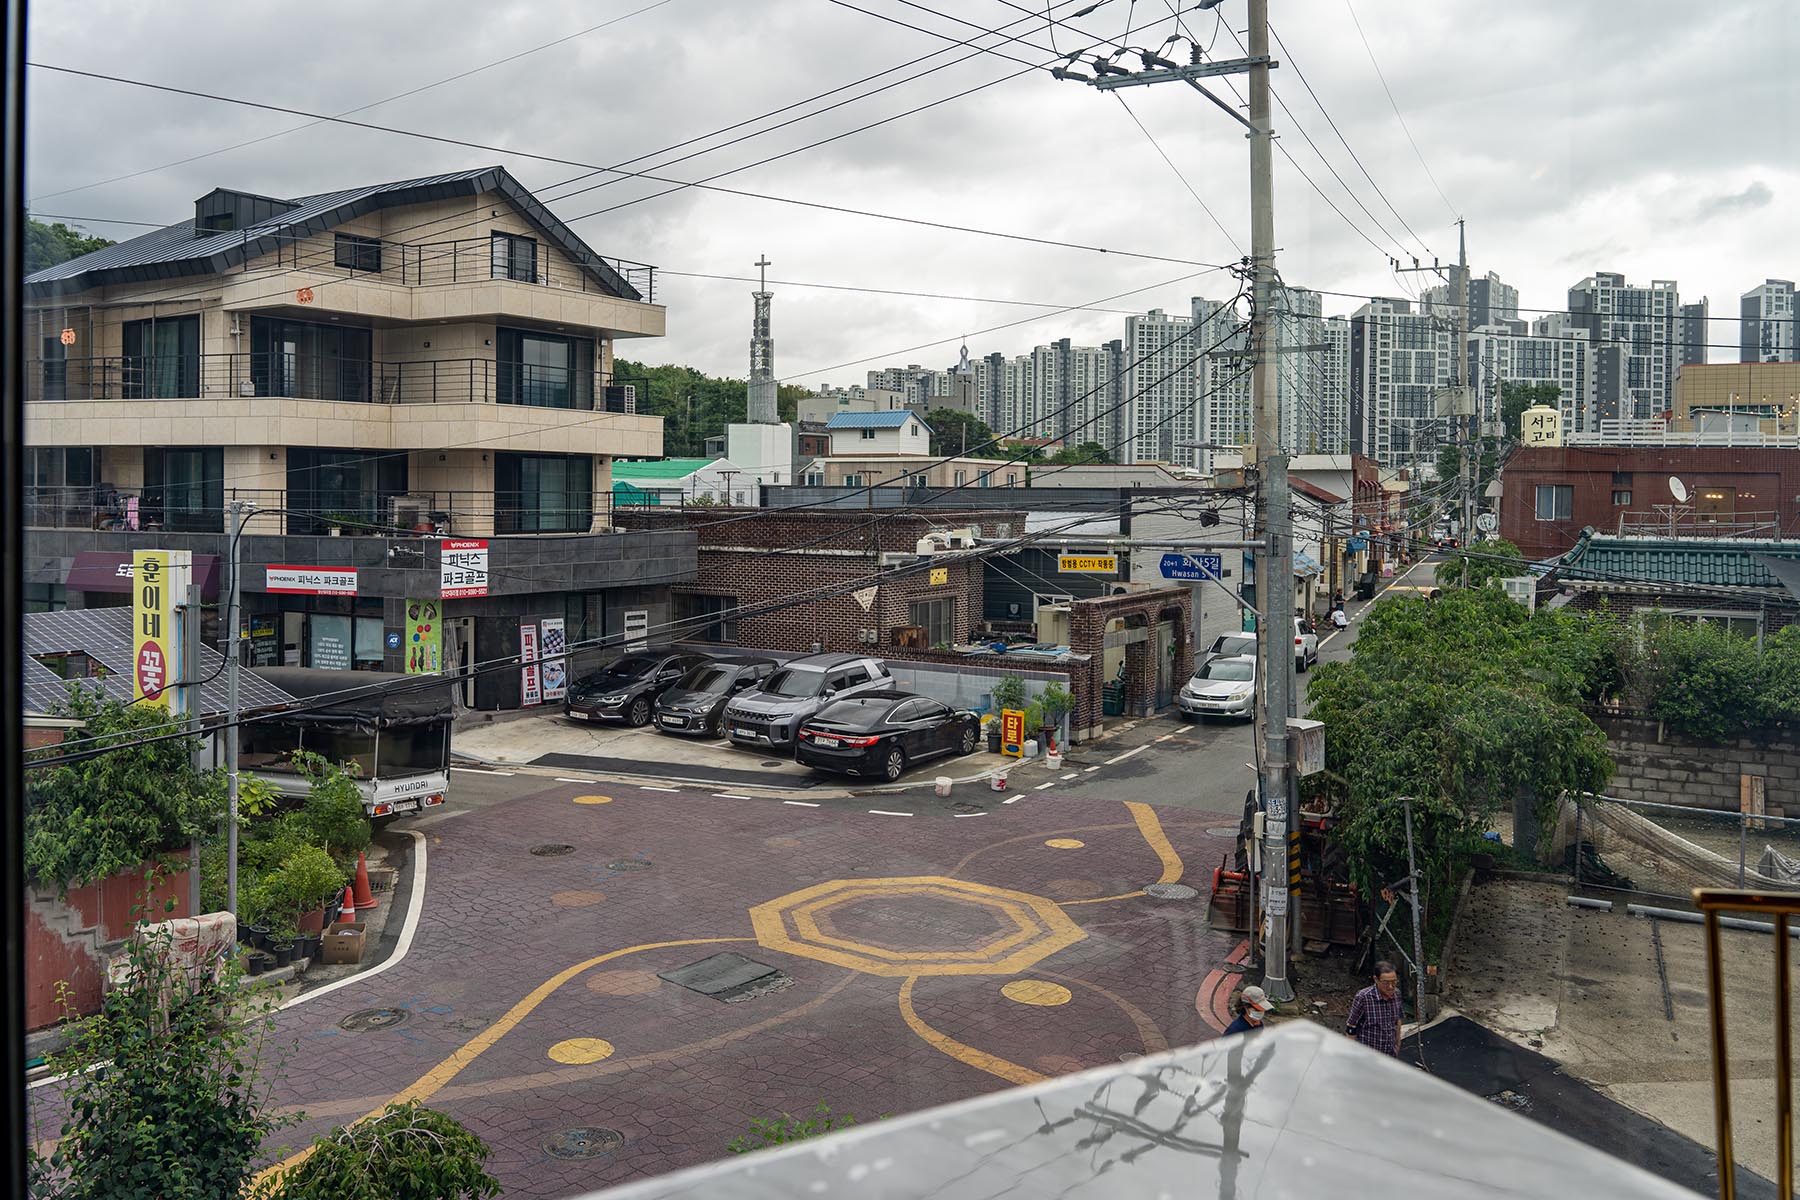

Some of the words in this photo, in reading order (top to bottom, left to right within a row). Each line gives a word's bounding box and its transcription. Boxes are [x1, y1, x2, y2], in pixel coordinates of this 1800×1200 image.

[449, 553, 481, 567] 피닉스
[1079, 559, 1096, 568] CCTV
[297, 575, 321, 585] 피닉스
[323, 576, 355, 586] 파크골프
[443, 571, 486, 586] 파크골프
[1171, 570, 1199, 578] Hwasan
[142, 557, 161, 638] 훈이네
[525, 634, 537, 691] 파크골프
[141, 650, 162, 695] 꽃
[1007, 716, 1018, 742] 타로
[394, 780, 428, 793] HYUNDAI
